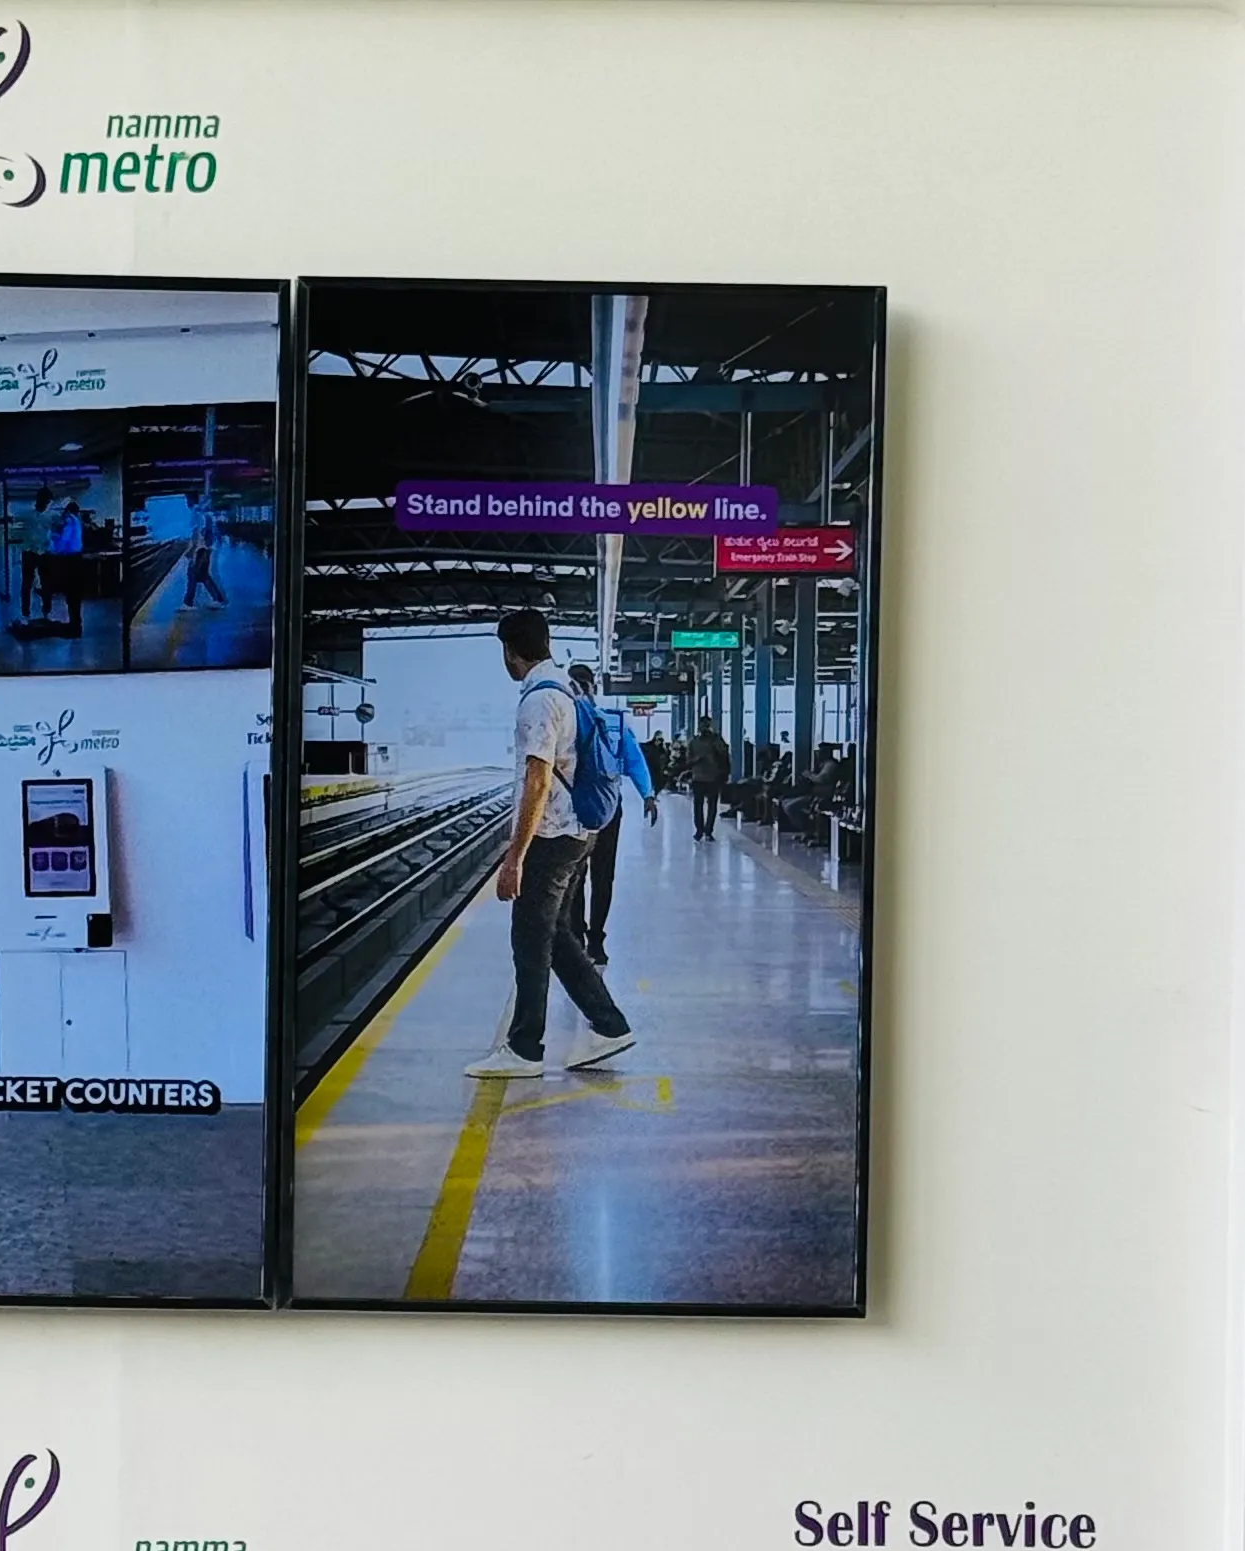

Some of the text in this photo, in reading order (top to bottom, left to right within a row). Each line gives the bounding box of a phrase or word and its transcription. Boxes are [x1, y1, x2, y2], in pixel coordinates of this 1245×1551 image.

[107, 114, 219, 139] namma
[60, 144, 218, 193] metro
[407, 494, 768, 524] Stand behind the yellow line.
[65, 1080, 214, 1108] COUNTERS
[794, 1500, 1096, 1549] Self Service
